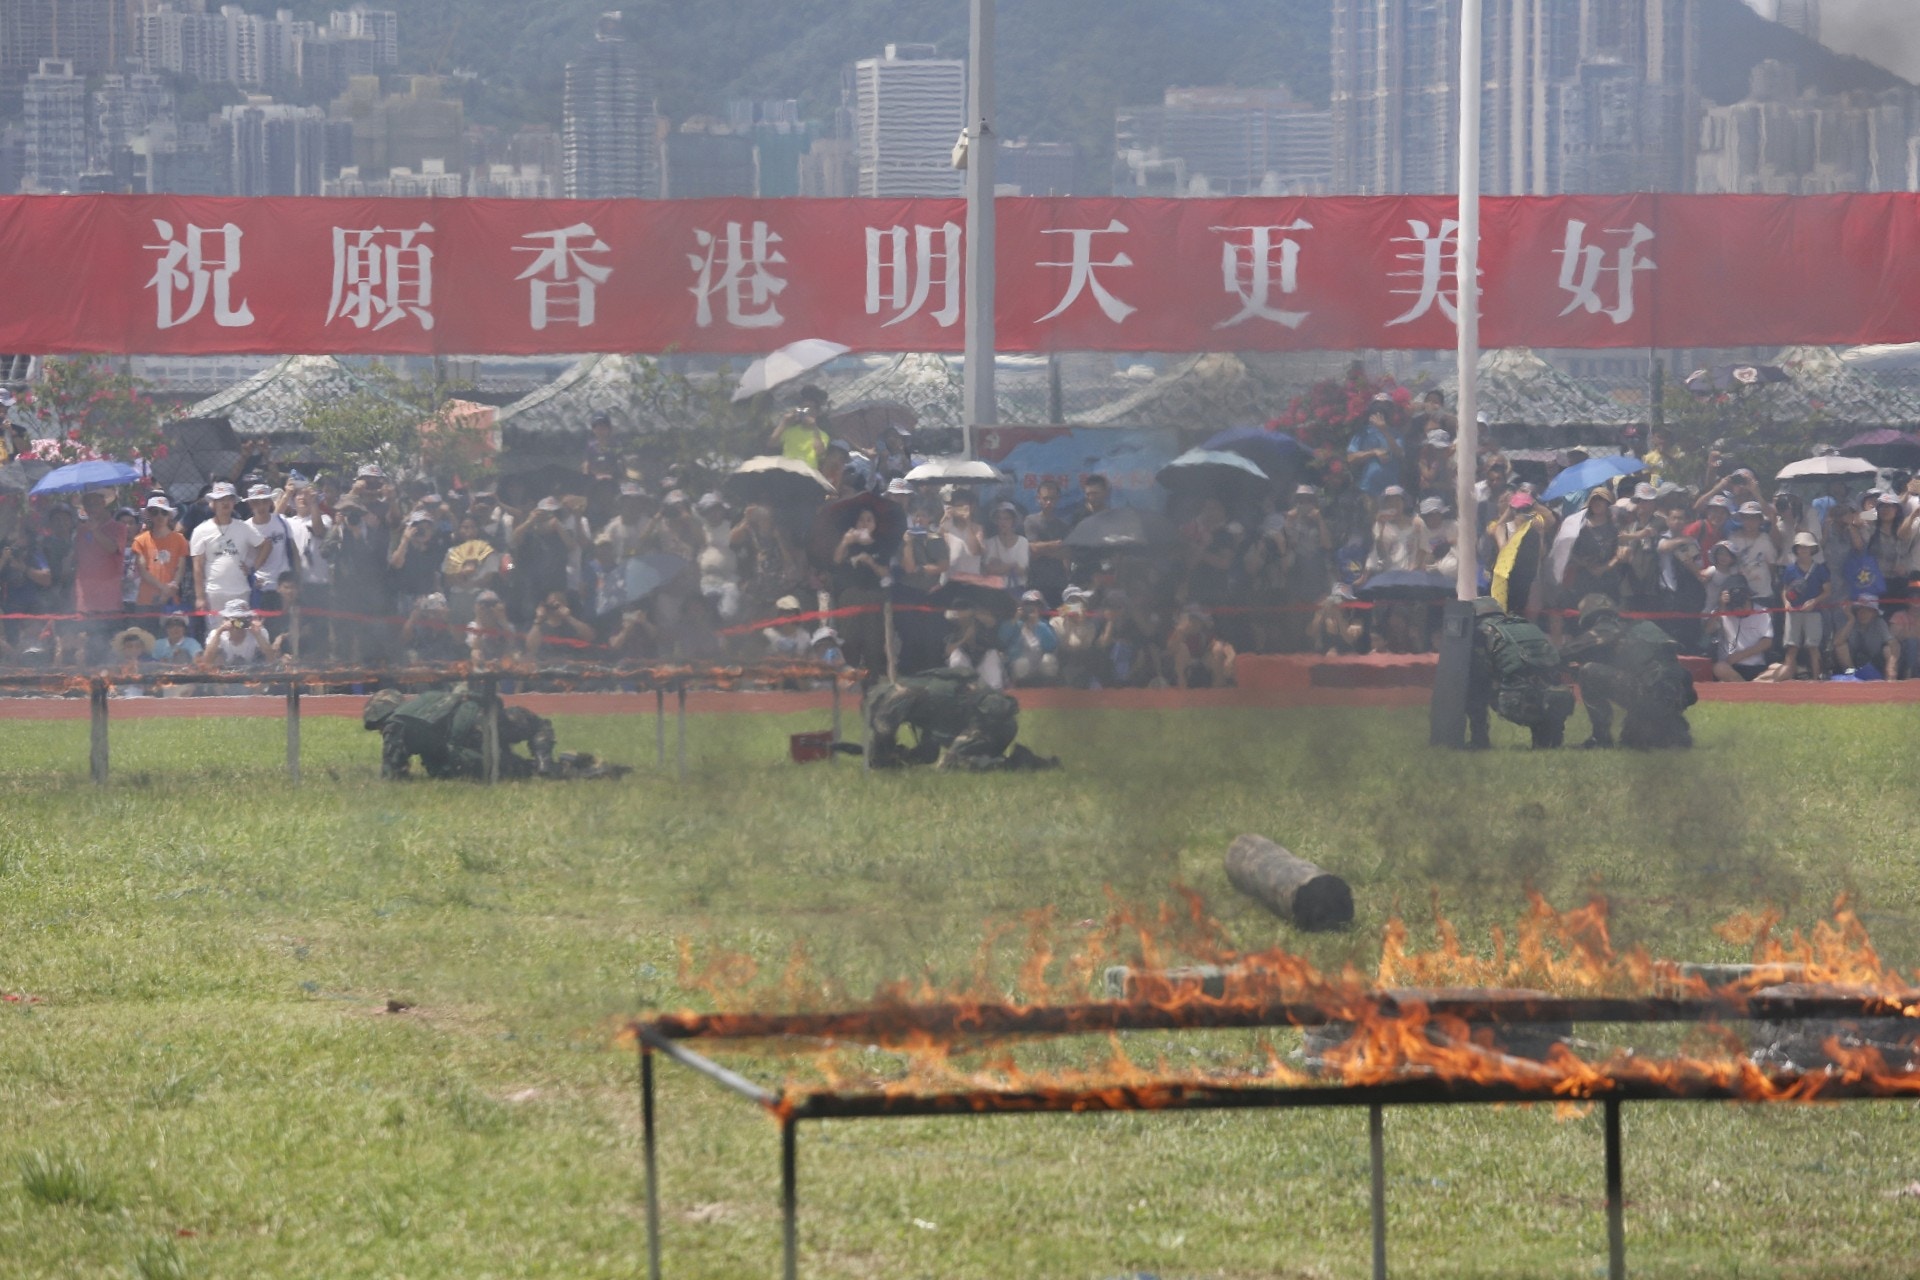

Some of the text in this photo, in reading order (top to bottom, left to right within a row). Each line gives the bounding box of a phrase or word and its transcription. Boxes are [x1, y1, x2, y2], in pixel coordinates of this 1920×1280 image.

[142, 218, 1657, 331] 祝願香港明天更美好
